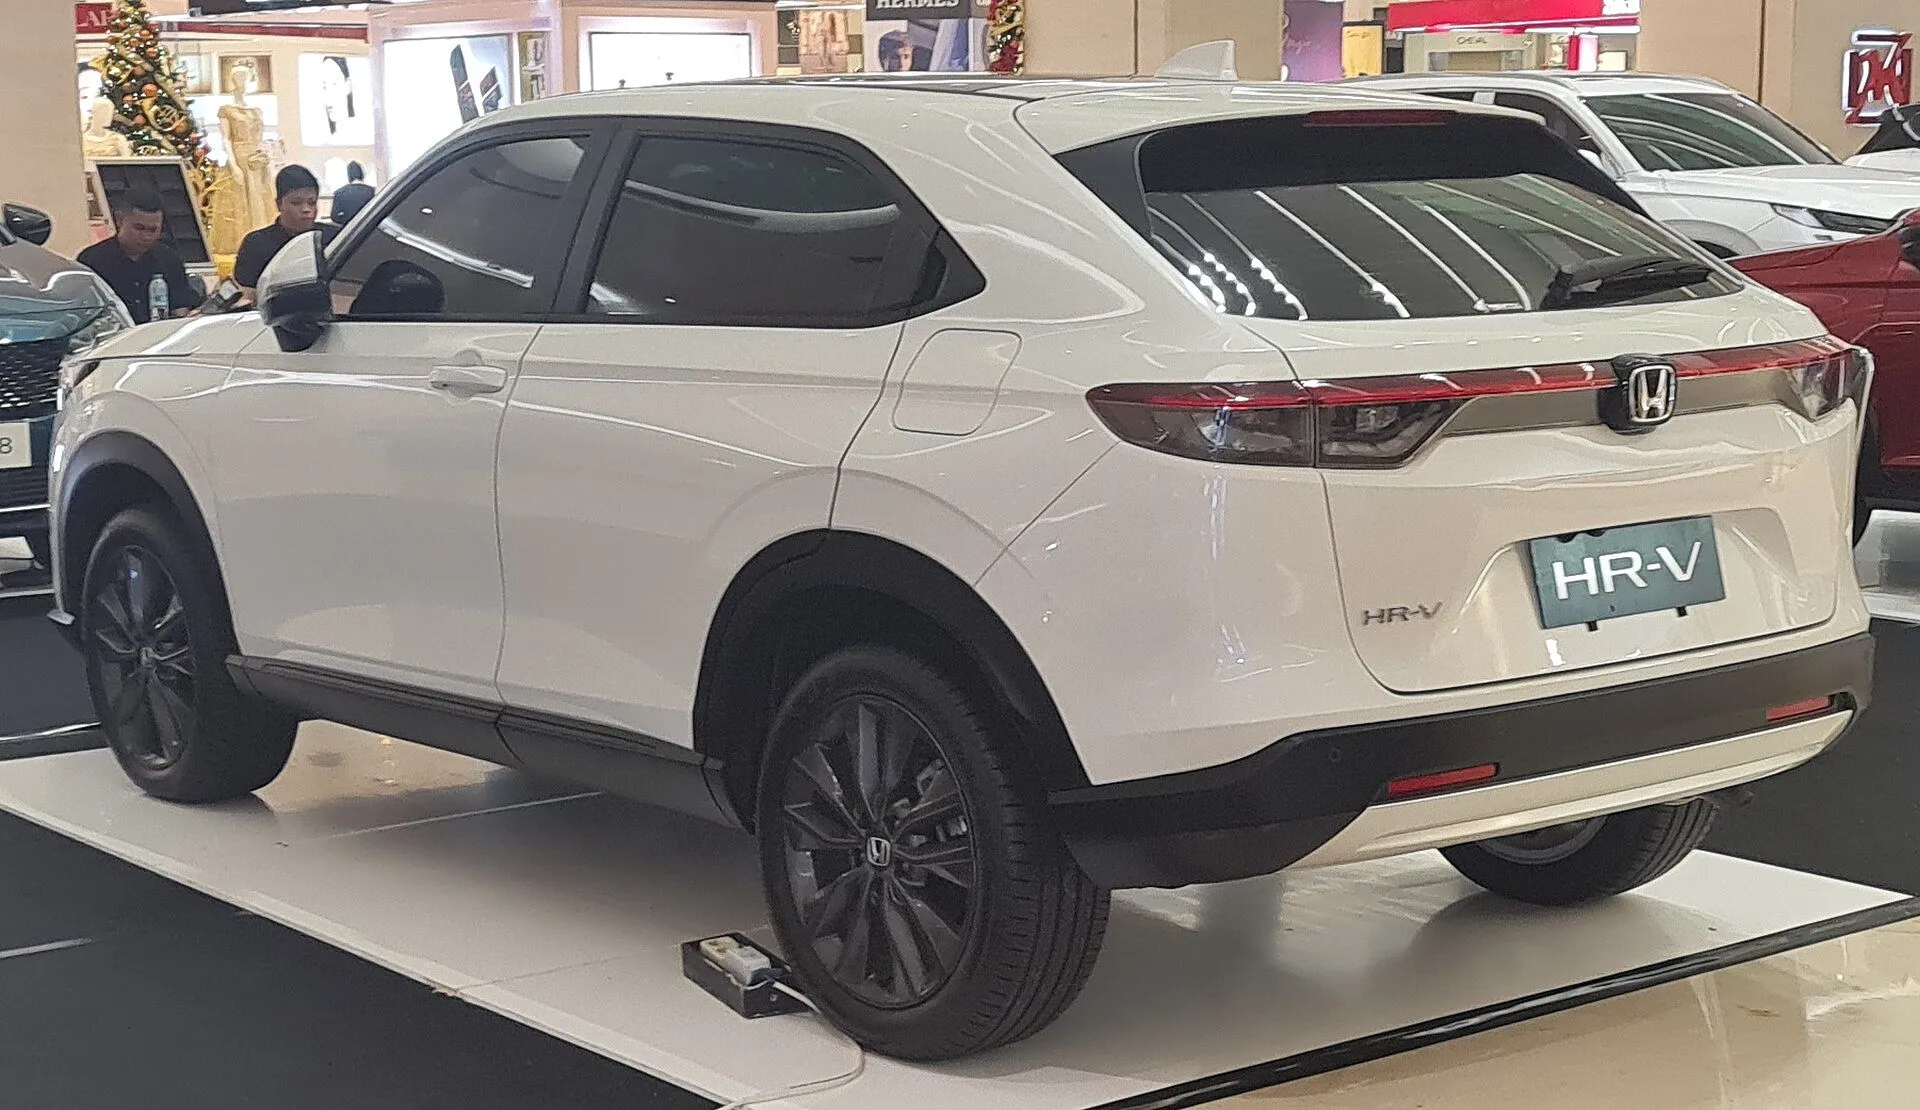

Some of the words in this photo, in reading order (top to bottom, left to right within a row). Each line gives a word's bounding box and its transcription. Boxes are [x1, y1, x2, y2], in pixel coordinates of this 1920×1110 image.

[0, 437, 12, 454] 8
[1552, 541, 1702, 600] HR-V
[1363, 602, 1442, 625] HR-V
